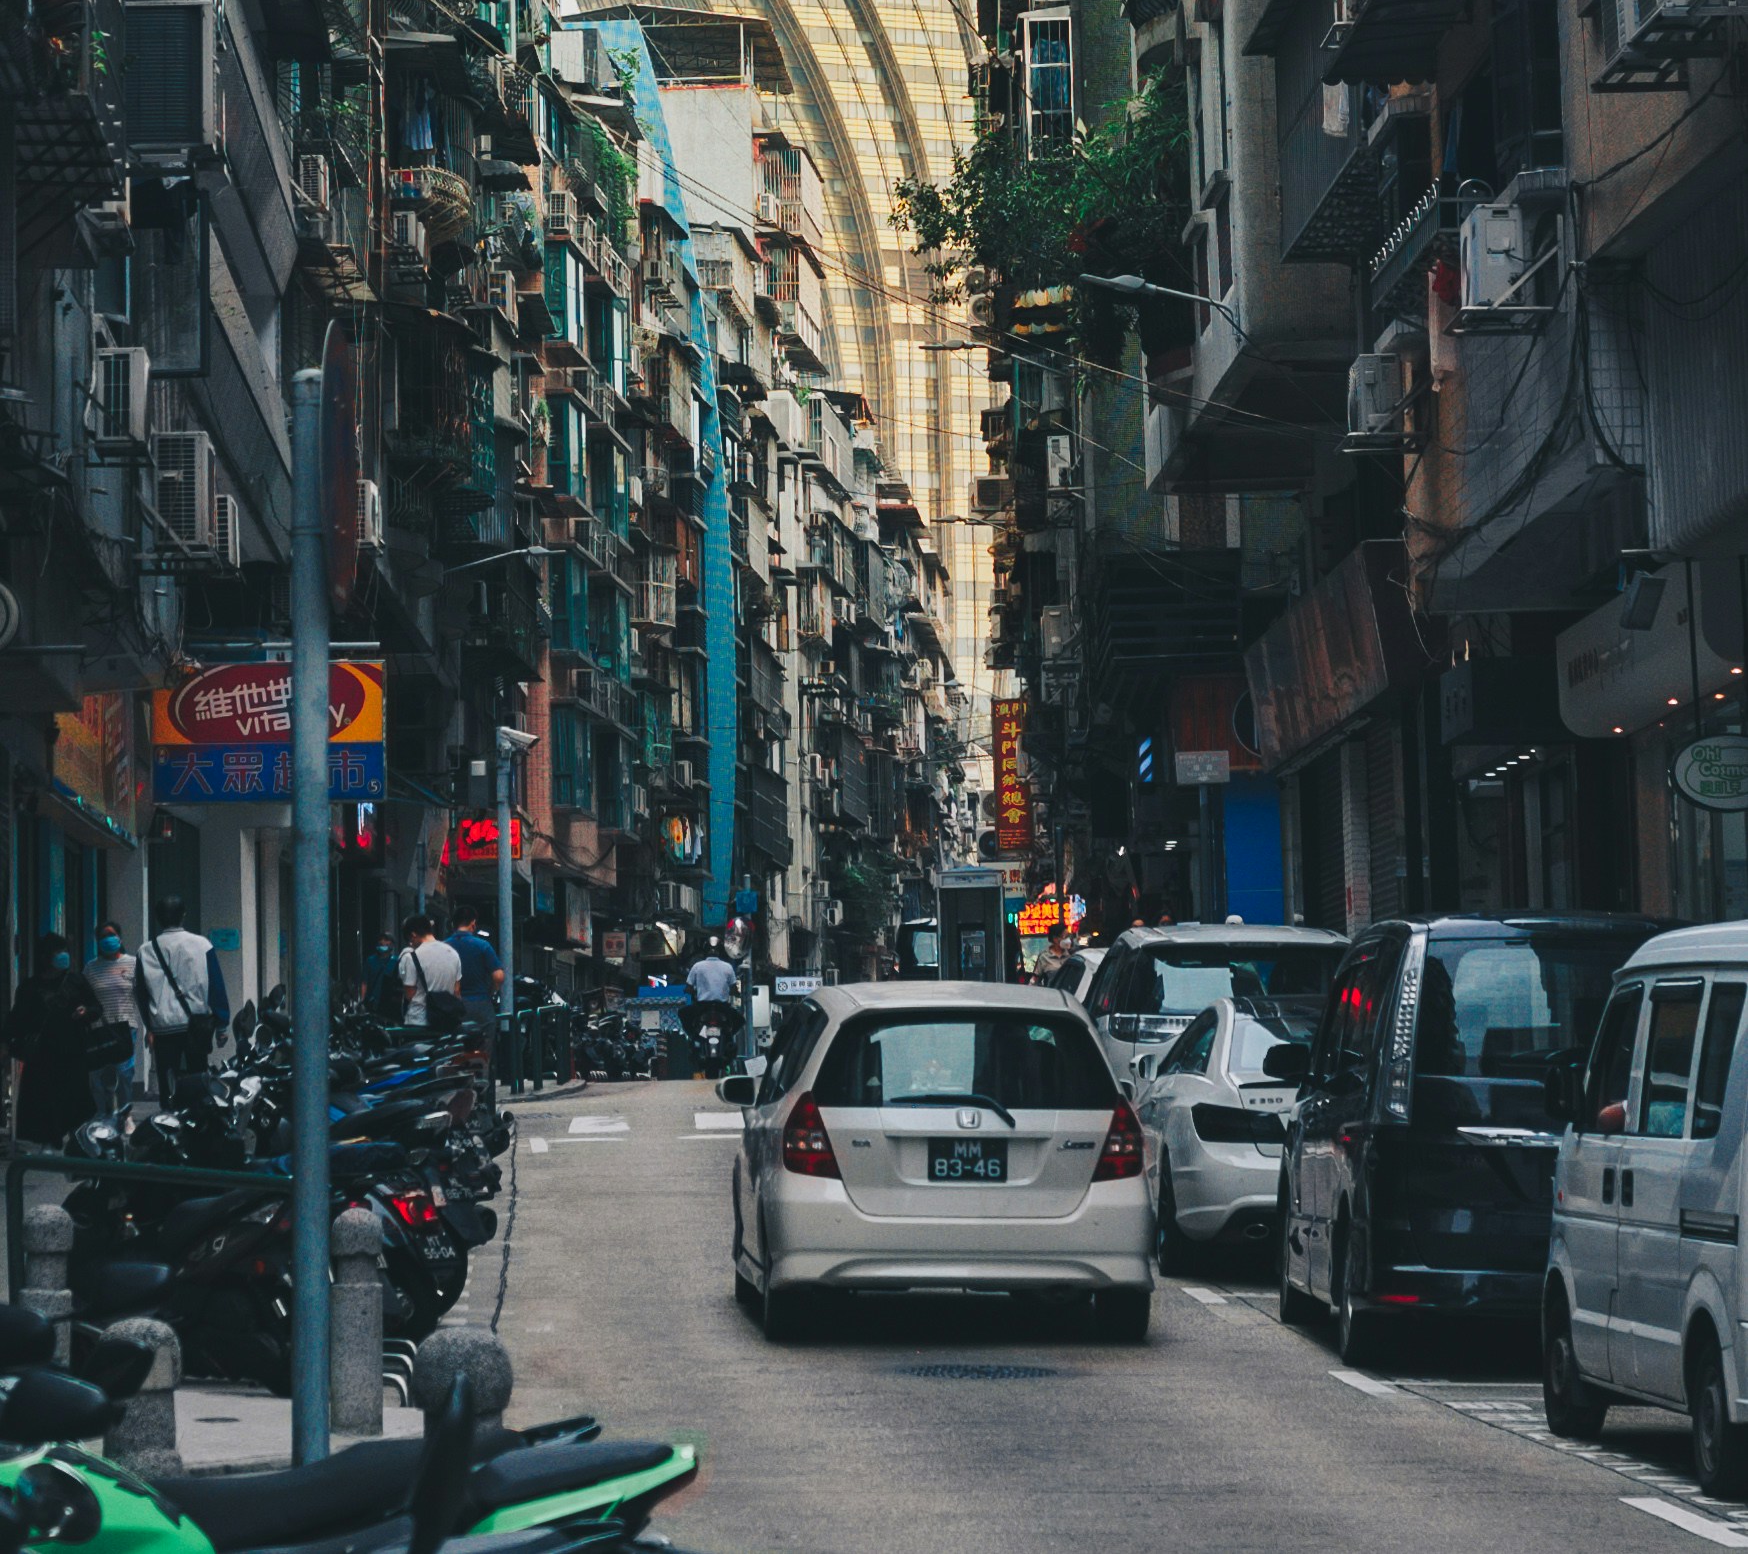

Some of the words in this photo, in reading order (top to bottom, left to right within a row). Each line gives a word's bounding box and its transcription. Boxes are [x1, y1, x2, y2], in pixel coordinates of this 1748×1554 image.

[236, 702, 346, 736] vitay
[954, 1142, 982, 1158] MM
[934, 1158, 1001, 1177] 83-46
